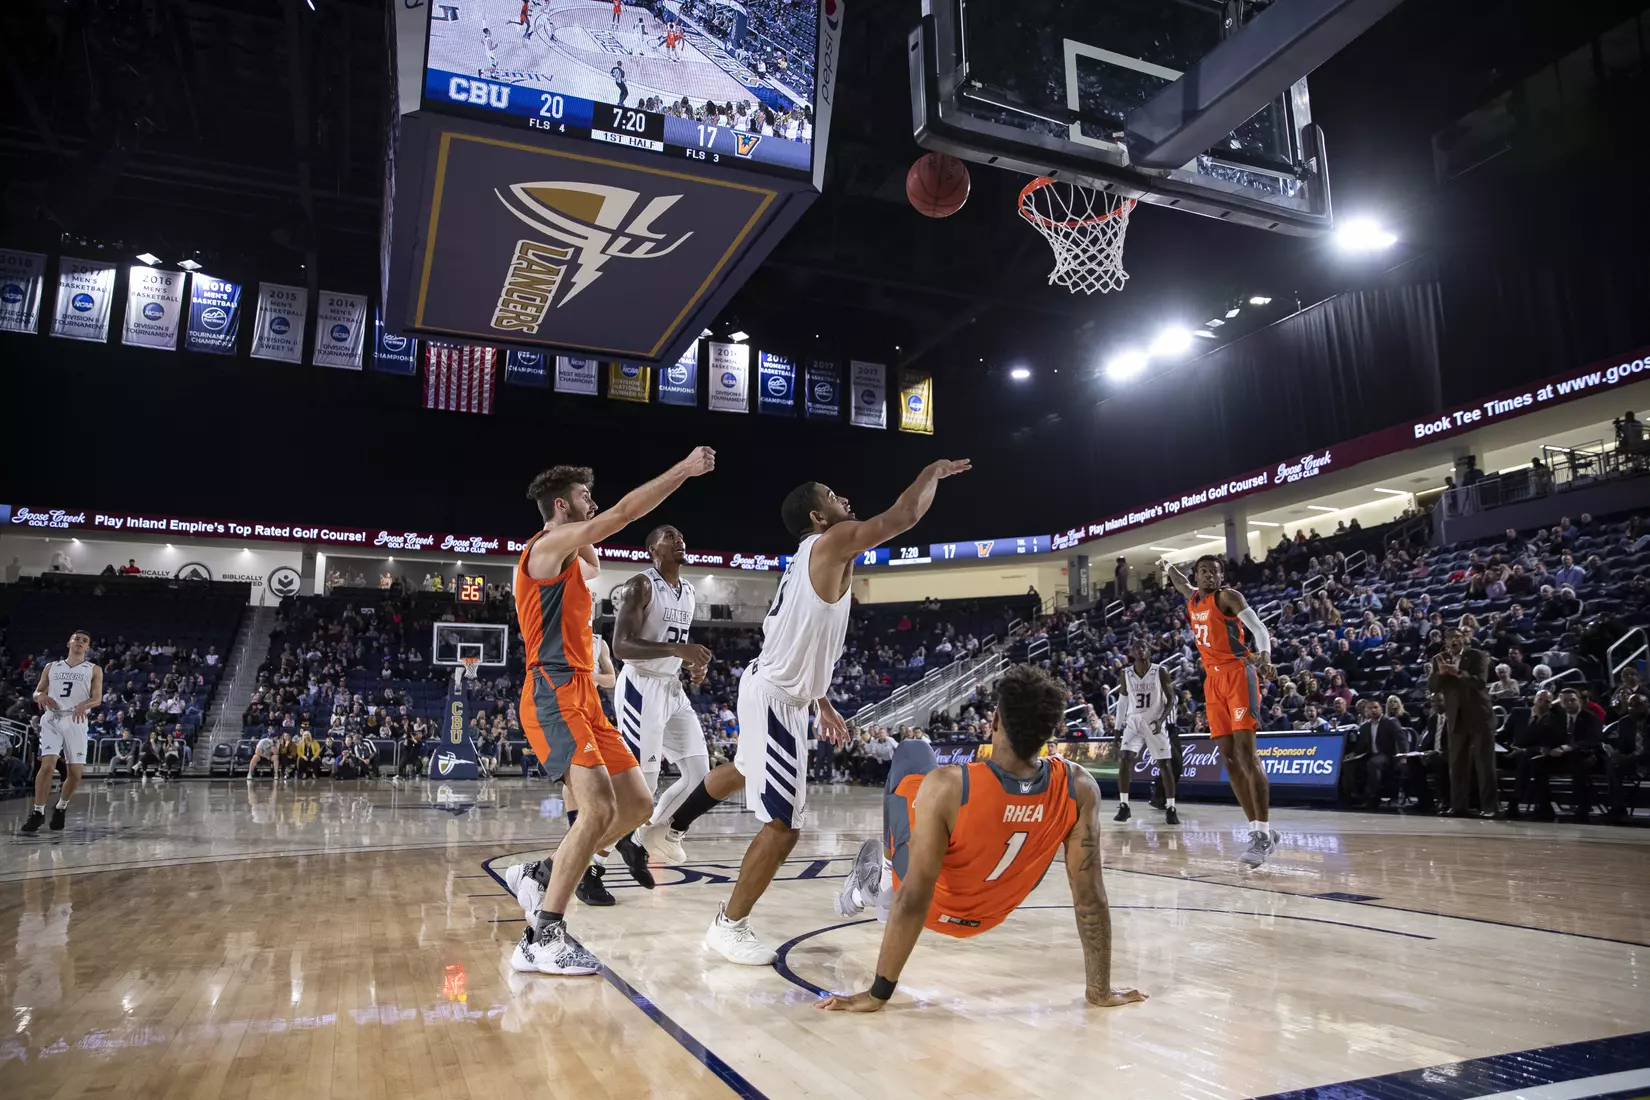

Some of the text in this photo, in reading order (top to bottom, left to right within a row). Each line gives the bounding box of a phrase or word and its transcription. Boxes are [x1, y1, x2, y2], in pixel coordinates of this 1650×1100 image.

[820, 30, 835, 106] pepsi
[448, 76, 564, 119] CBU 20
[529, 117, 566, 133] FLS 4
[613, 108, 645, 132] 7:20
[603, 132, 656, 149] 1ST HALF
[697, 124, 717, 148] 17
[685, 148, 719, 163] FLS 3
[72, 264, 103, 276] 2017
[72, 275, 97, 285] MEN'S
[143, 274, 172, 286] 2016
[143, 285, 167, 293] MEN'S
[203, 281, 233, 293] 2016
[490, 239, 575, 334] LANCERS
[204, 291, 228, 300] MEN'S
[269, 289, 297, 301] 2015
[192, 297, 238, 308] BASKETBALL
[270, 300, 292, 309] MEN'S
[328, 298, 355, 309] 2014
[259, 306, 303, 317] BASKETBALL
[330, 308, 352, 316] MEN'S
[54, 318, 107, 330] TOURNAMENT
[61, 313, 94, 323] DIVISION
[133, 322, 164, 331] DIVISION
[126, 327, 175, 339] TOURNAMENT
[258, 336, 293, 345] DIVISION
[260, 343, 284, 351] SWEET
[323, 344, 351, 352] DIVISION
[373, 352, 414, 362] CHAMPIONS
[560, 376, 594, 385] CHAMPIONS
[659, 385, 695, 394] CHAMPIONS
[1414, 355, 1650, 439] Book Tee Times at www.goos
[1274, 450, 1331, 484] Goose Creek
[1286, 467, 1320, 482] GOLF CLUB
[1088, 472, 1268, 537] Play Inland Empire's Top Rated Golf Course!
[12, 507, 86, 524] Goose Creek
[28, 519, 69, 529] GOLF CLUB
[95, 514, 366, 542] Play Inland Empire's Top Rated Golf Course!
[374, 530, 434, 546] Goose Creek
[440, 535, 499, 550] Goose Creek
[863, 550, 877, 565] 20
[900, 547, 919, 559] 7:20
[943, 544, 957, 559] 17
[729, 553, 756, 568] Goose
[754, 554, 780, 567] Creek
[222, 573, 263, 581] BIBLICALLY
[465, 576, 483, 586] 7:19
[461, 585, 480, 600] 26
[60, 681, 73, 698] 3
[1135, 693, 1150, 709] 31
[450, 701, 463, 744] CBU
[1256, 746, 1317, 758] oud Sponsor of
[1002, 803, 1044, 823] RHEA
[984, 831, 1030, 882] 1
